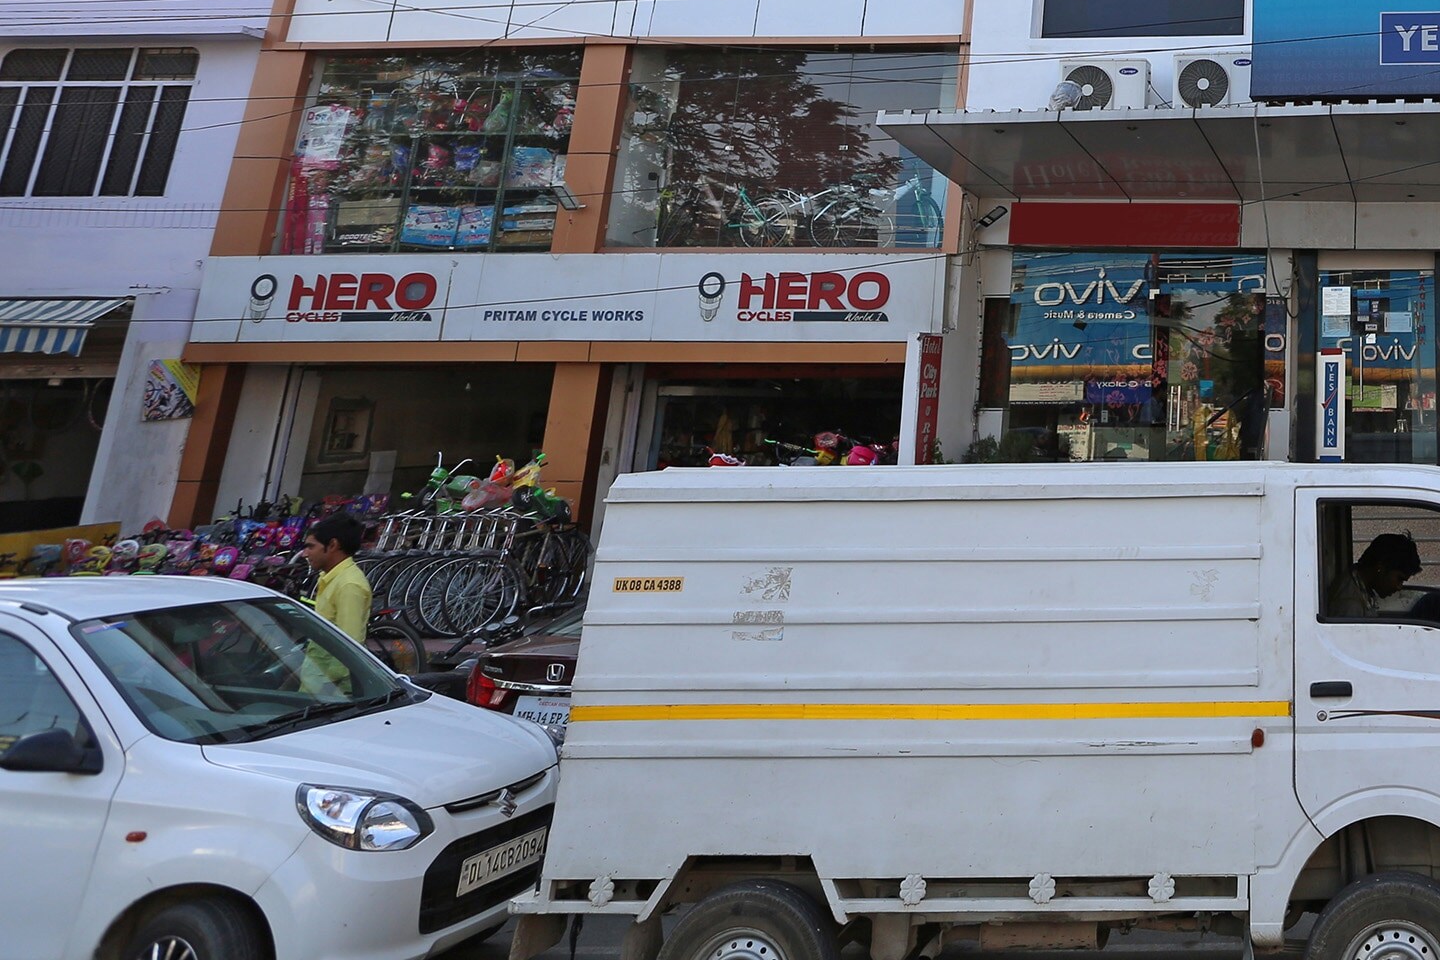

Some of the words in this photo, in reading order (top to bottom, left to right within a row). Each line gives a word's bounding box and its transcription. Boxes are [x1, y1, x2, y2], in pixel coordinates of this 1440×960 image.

[287, 272, 437, 311] HERO
[738, 271, 891, 310] HERO
[286, 312, 339, 322] CYCLES
[483, 310, 537, 321] PRITAM
[541, 310, 588, 321] CYCLE
[591, 310, 644, 321] WORKS
[737, 312, 792, 322] CYCLES
[844, 312, 874, 322] World
[924, 364, 937, 383] City
[1327, 364, 1335, 391] YES
[921, 383, 937, 399] Park
[1327, 408, 1335, 446] BANK
[616, 580, 629, 591] UK
[629, 580, 642, 590] 08
[643, 580, 656, 590] CA
[657, 579, 682, 590] 4388
